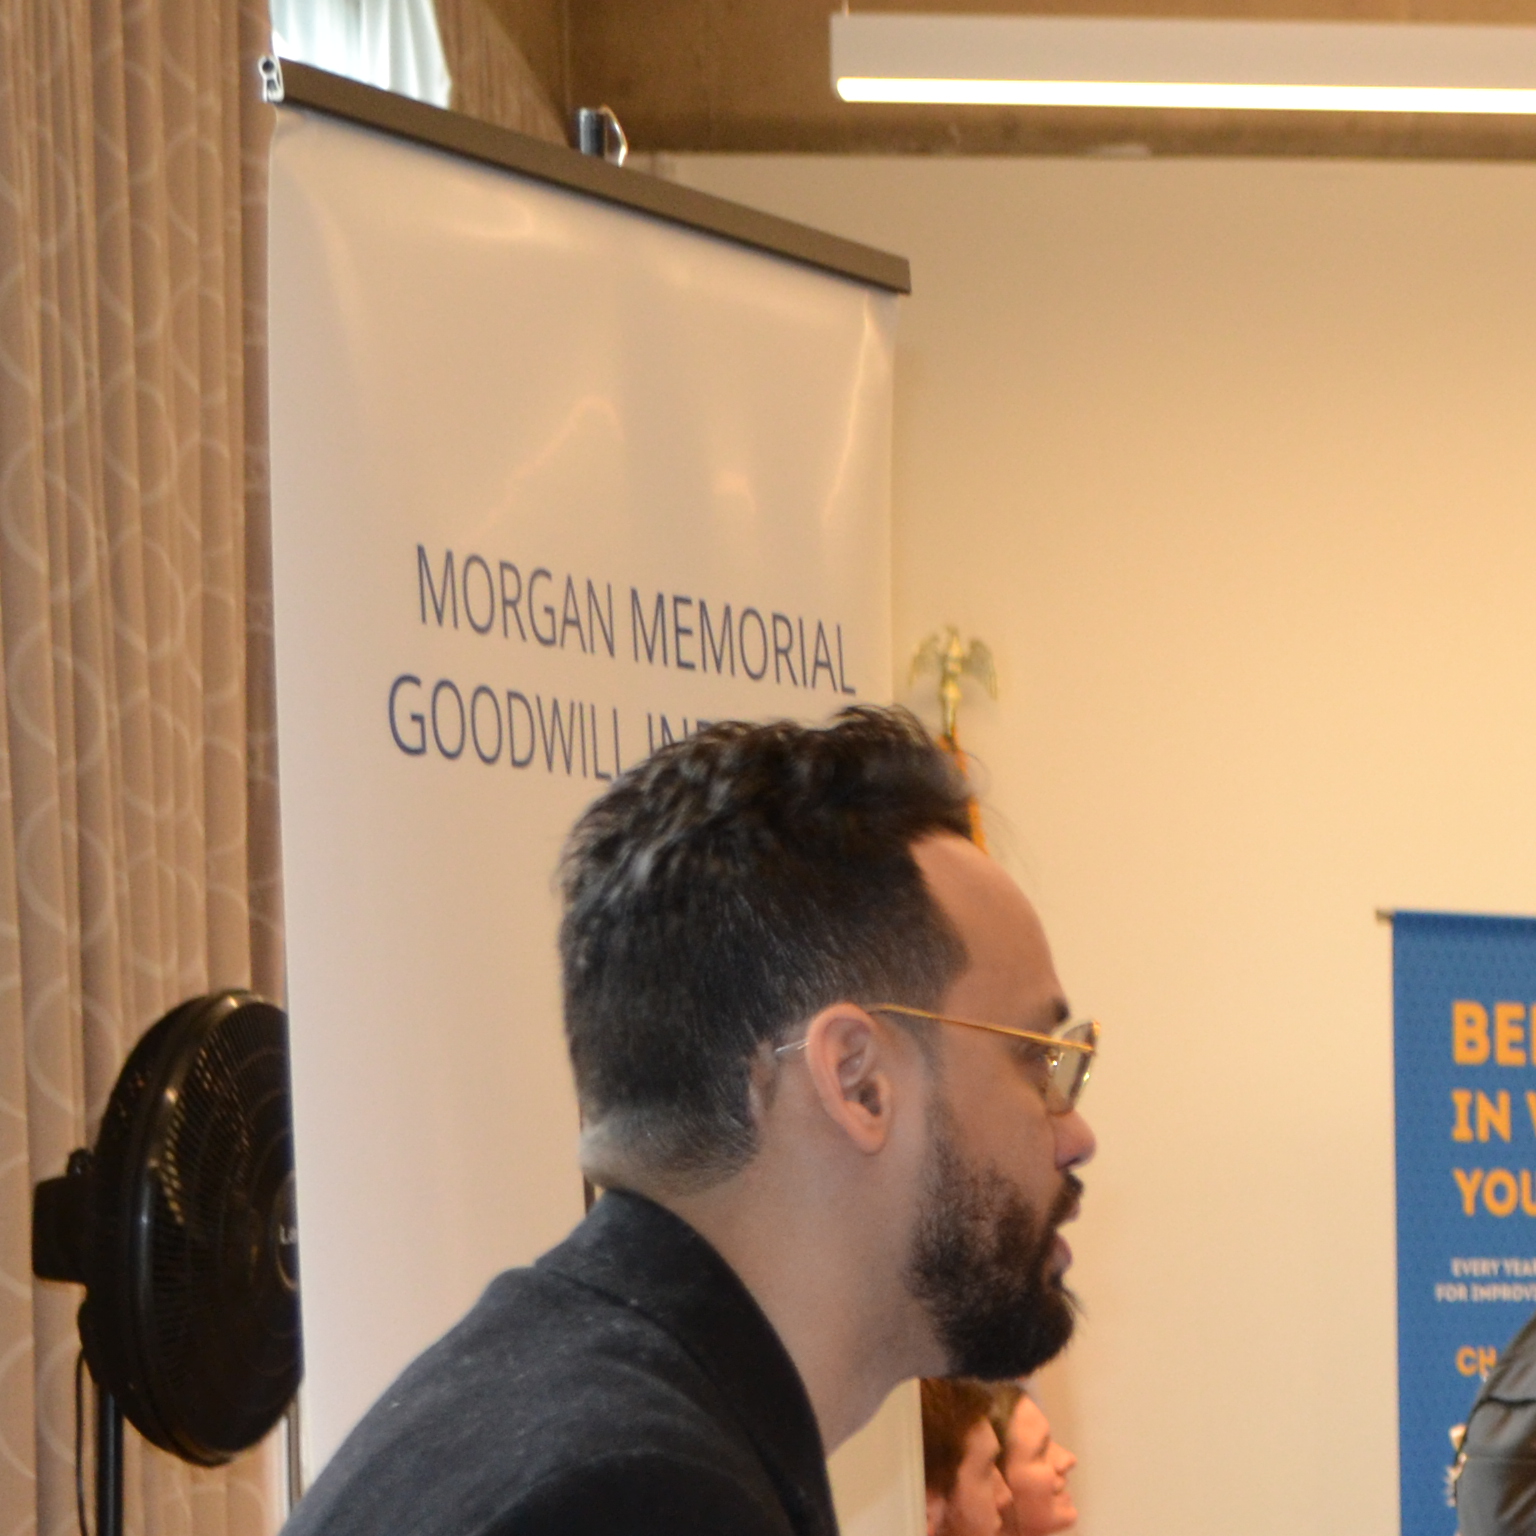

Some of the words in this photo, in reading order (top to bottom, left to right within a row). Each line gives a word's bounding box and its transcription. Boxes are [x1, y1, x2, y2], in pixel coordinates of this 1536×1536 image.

[416, 542, 616, 660] MORGAN
[630, 587, 857, 698] MEMORIAL
[387, 673, 624, 783] GOODWILL
[1451, 1089, 1511, 1143] IN
[1435, 1282, 1469, 1302] FOR
[1451, 1257, 1500, 1277] EVERY
